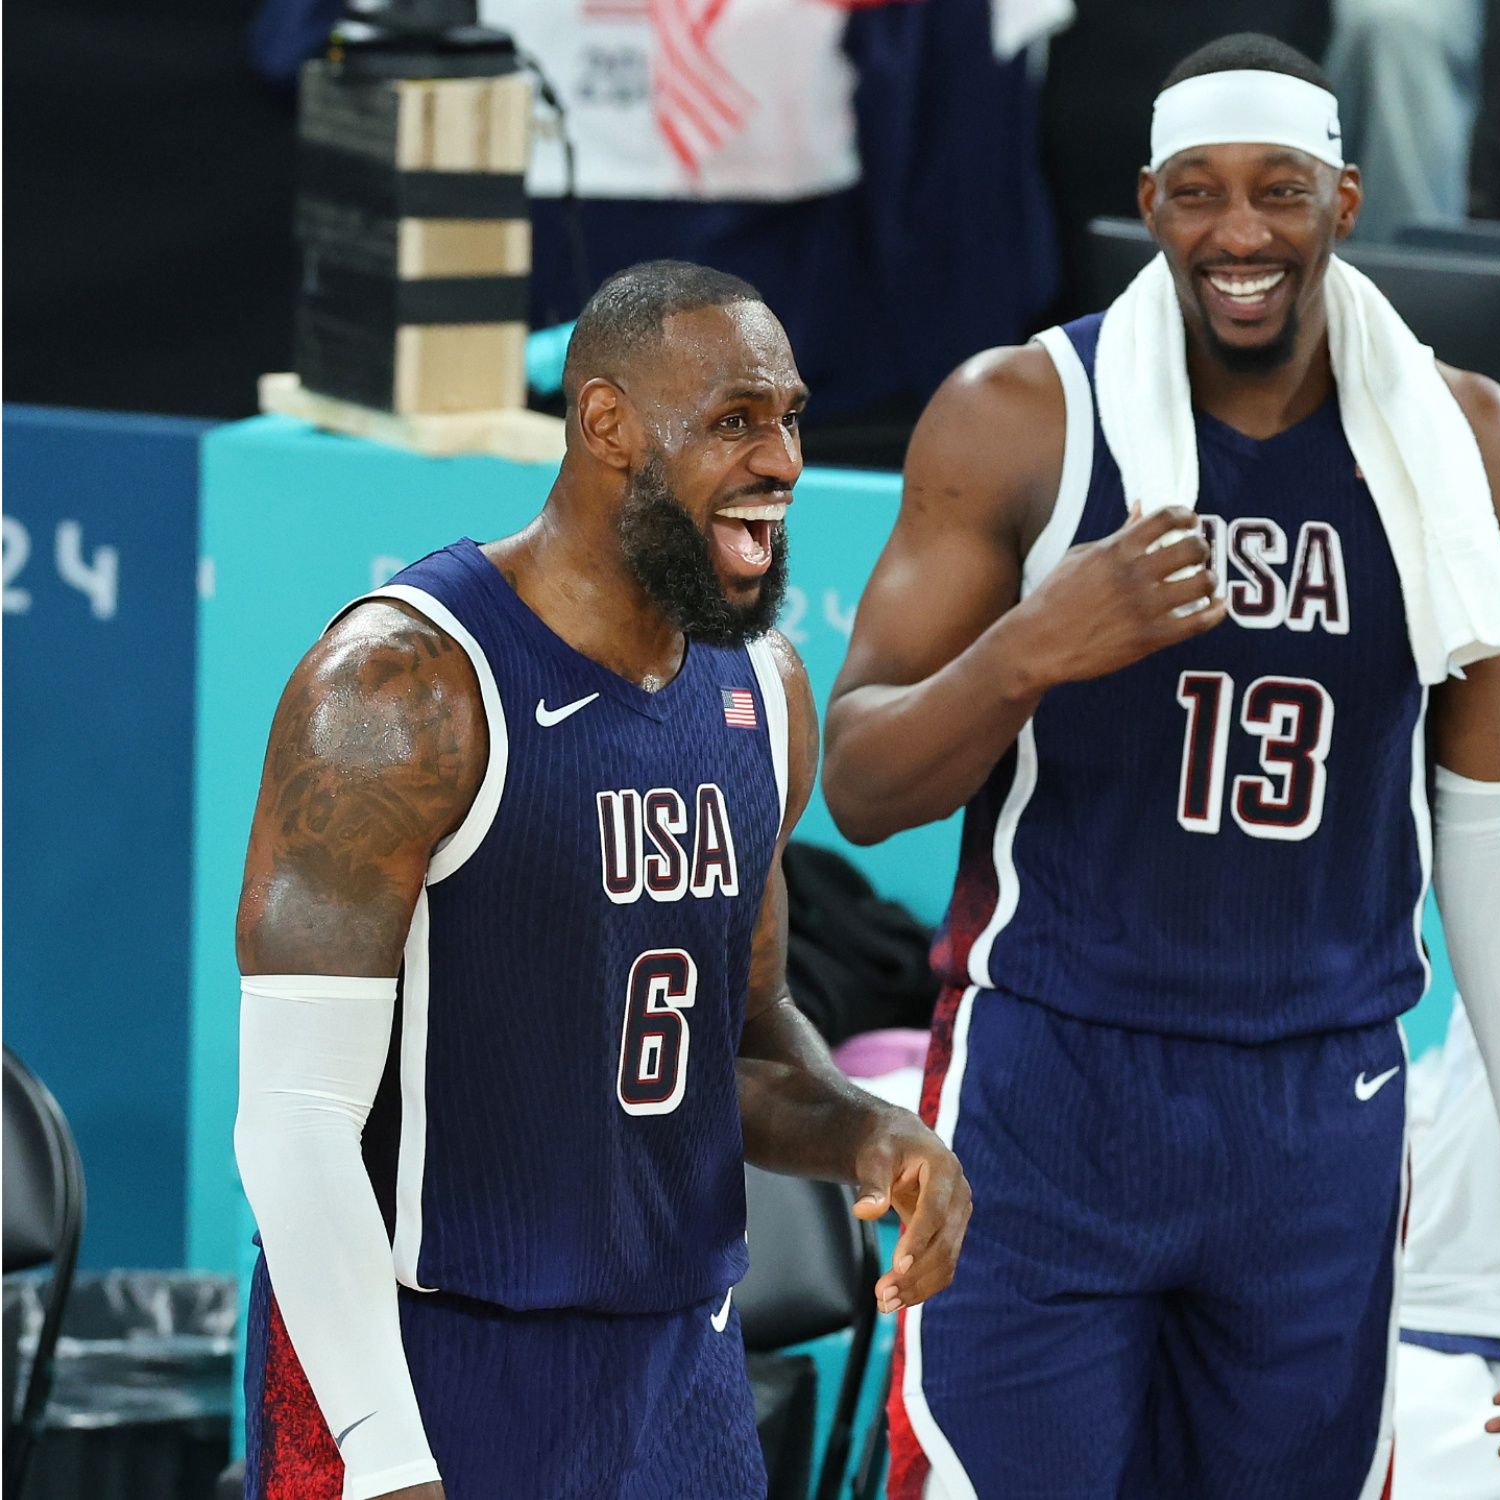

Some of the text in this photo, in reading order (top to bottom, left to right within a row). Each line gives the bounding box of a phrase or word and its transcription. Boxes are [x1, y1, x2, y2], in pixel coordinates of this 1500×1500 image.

[1177, 670, 1335, 841] 13
[597, 783, 739, 904] USA
[617, 949, 697, 1116] 6
